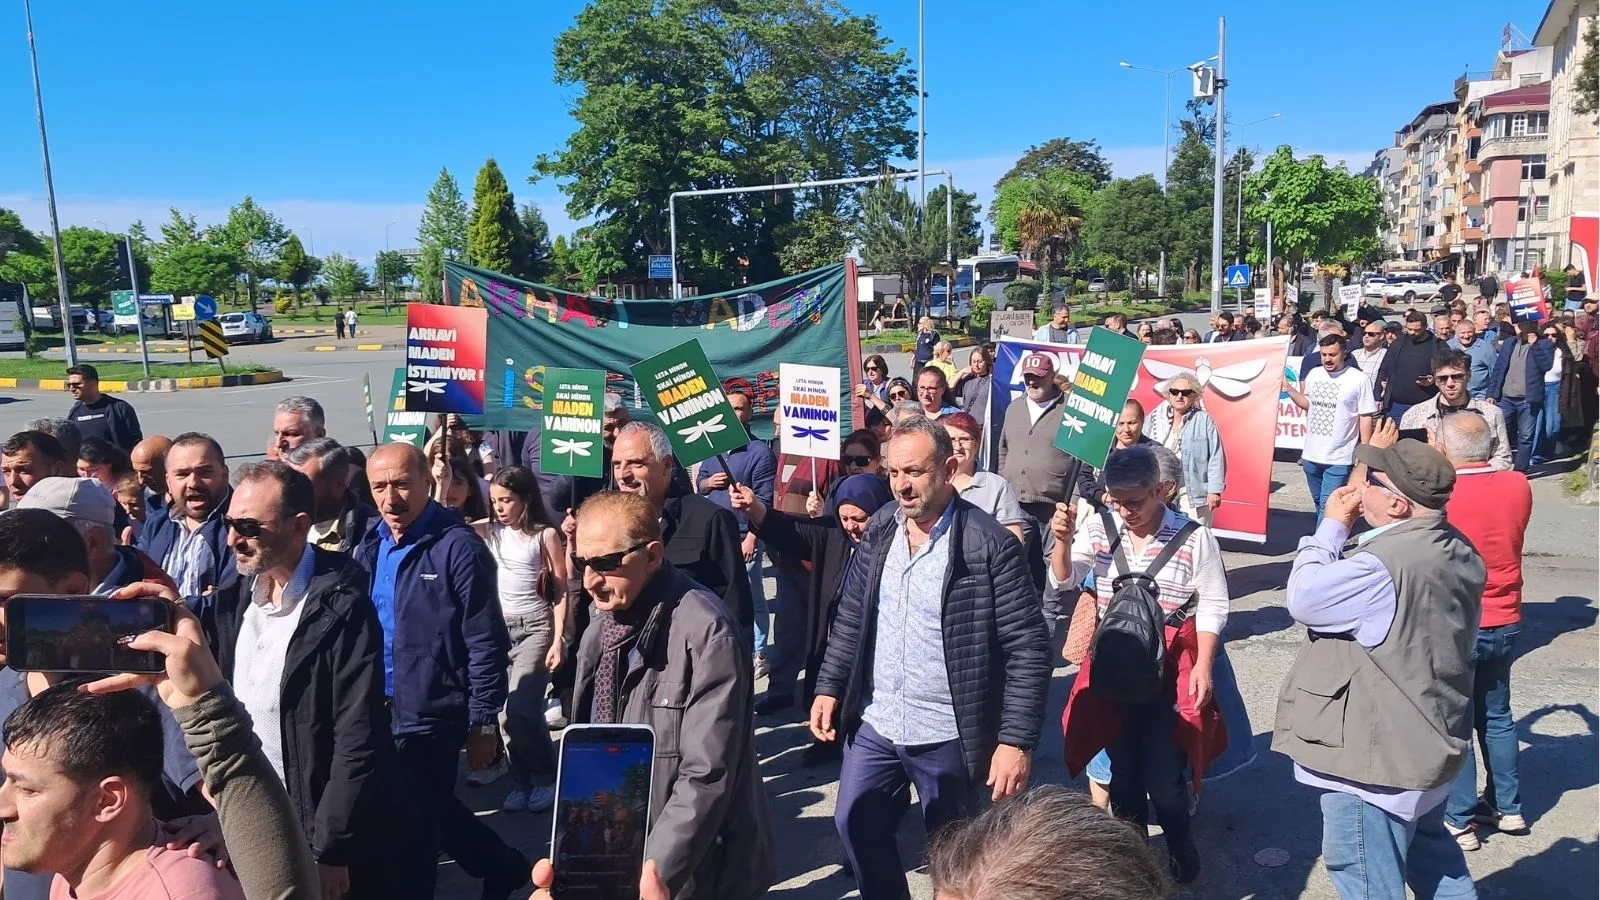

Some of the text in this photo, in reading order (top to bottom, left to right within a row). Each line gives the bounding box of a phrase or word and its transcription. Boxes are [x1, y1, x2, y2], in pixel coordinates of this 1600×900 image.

[409, 326, 457, 343] ARHAVİ
[408, 346, 455, 361] MADEN
[1025, 357, 1040, 368] 10
[1080, 350, 1117, 375] ARHAVİ
[407, 363, 476, 382] İSTEMİYOR
[654, 361, 688, 380] LETA MİNON
[656, 369, 697, 391] SKAİ MİNON
[657, 375, 708, 407] MADEN
[1074, 371, 1108, 397] MADEN
[552, 399, 593, 417] MADEN
[656, 387, 726, 426] VAMİNON
[791, 392, 829, 407] MADEN
[783, 405, 837, 423] VAMİNON
[544, 415, 601, 434] VAMİNON
